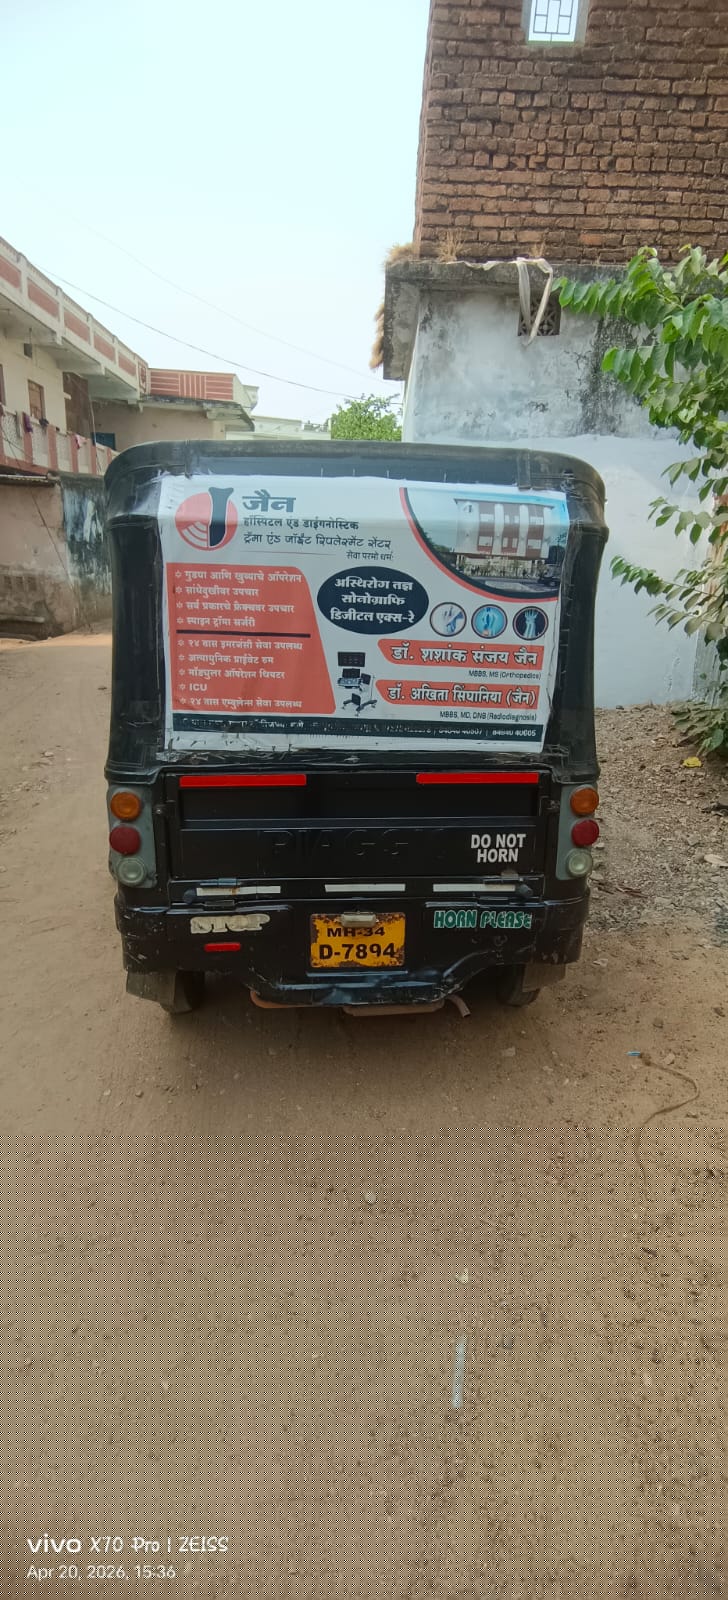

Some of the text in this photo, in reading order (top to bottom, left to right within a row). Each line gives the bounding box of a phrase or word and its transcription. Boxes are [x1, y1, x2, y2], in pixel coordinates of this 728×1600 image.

[242, 489, 297, 513] जैन
[346, 550, 361, 560] सेवा
[362, 551, 379, 561] परमो
[210, 569, 232, 580] आणि
[335, 576, 390, 589] अस्थिरोग
[232, 587, 259, 597] उपचार
[267, 604, 295, 614] उपचार
[330, 607, 415, 624] डिजीटल एक्स-रे
[188, 639, 200, 648] २४
[201, 639, 218, 649] तास
[255, 638, 272, 649] सेवा
[273, 642, 303, 651] उपलब्ध
[391, 642, 538, 666] डॉ. शशांक संजय जैन
[468, 670, 542, 680] MBBS, MS (Orthopedics)
[189, 683, 208, 692] ICU
[387, 683, 405, 700] डॉ.
[506, 687, 536, 707] (जैन)
[255, 696, 272, 708] सेवा
[439, 710, 459, 719] MBBS,
[460, 711, 471, 720] MD,
[487, 712, 537, 722] (Radiodiagnosis)
[471, 833, 527, 849] DO NOT
[476, 848, 519, 863] HORN
[433, 910, 533, 929] HORN PLEASE
[326, 927, 386, 938] MH-34
[318, 943, 398, 961] D-7894
